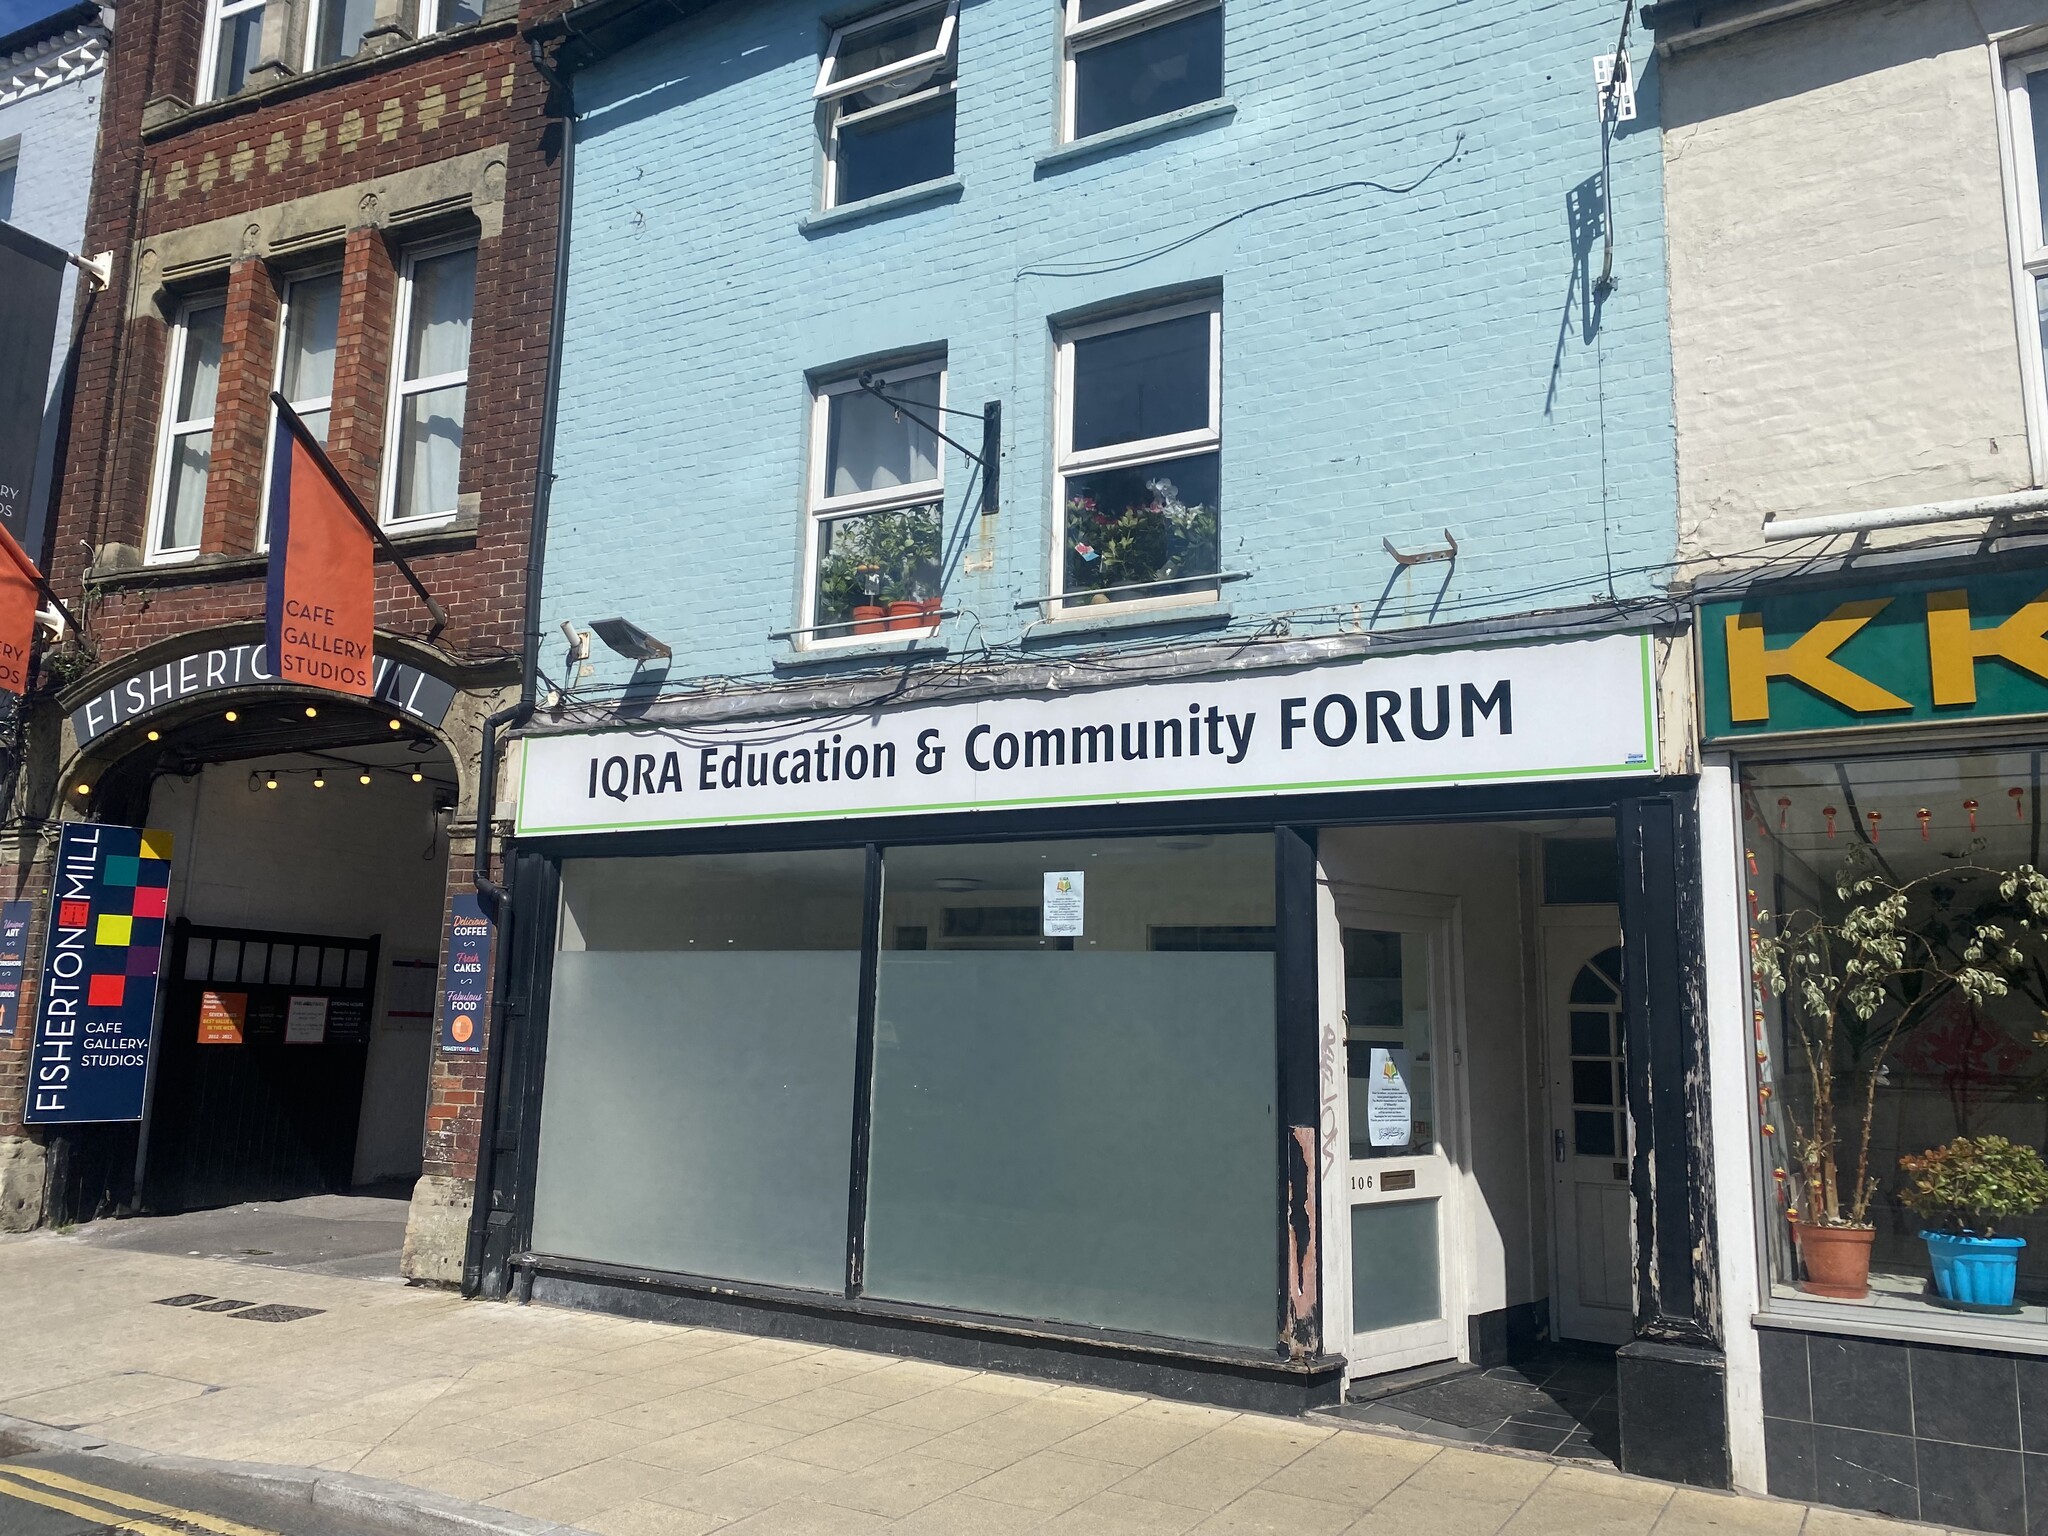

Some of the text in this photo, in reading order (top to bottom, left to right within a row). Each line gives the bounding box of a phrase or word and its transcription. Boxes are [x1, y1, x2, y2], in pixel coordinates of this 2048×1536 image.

[285, 600, 335, 626] CAFE
[284, 627, 367, 660] GALLERY
[283, 654, 367, 687] STUDIOS
[84, 643, 425, 738] FISHERTO ILL
[588, 679, 1513, 803] IQRA Education & Community FORUM
[453, 915, 489, 927] Delicious
[5, 928, 20, 937] ART
[454, 927, 487, 936] COFFEE
[456, 952, 480, 963] Fresh
[35, 828, 100, 1111] FISHERTON MILL
[453, 963, 482, 973] CAKES
[446, 990, 483, 1002] Fabulous
[451, 1001, 477, 1011] FOOD
[85, 1022, 122, 1034] CAFE
[83, 1038, 146, 1049] GALLERY
[80, 1054, 144, 1067] STUDIOS
[1351, 1175, 1373, 1190] 106
